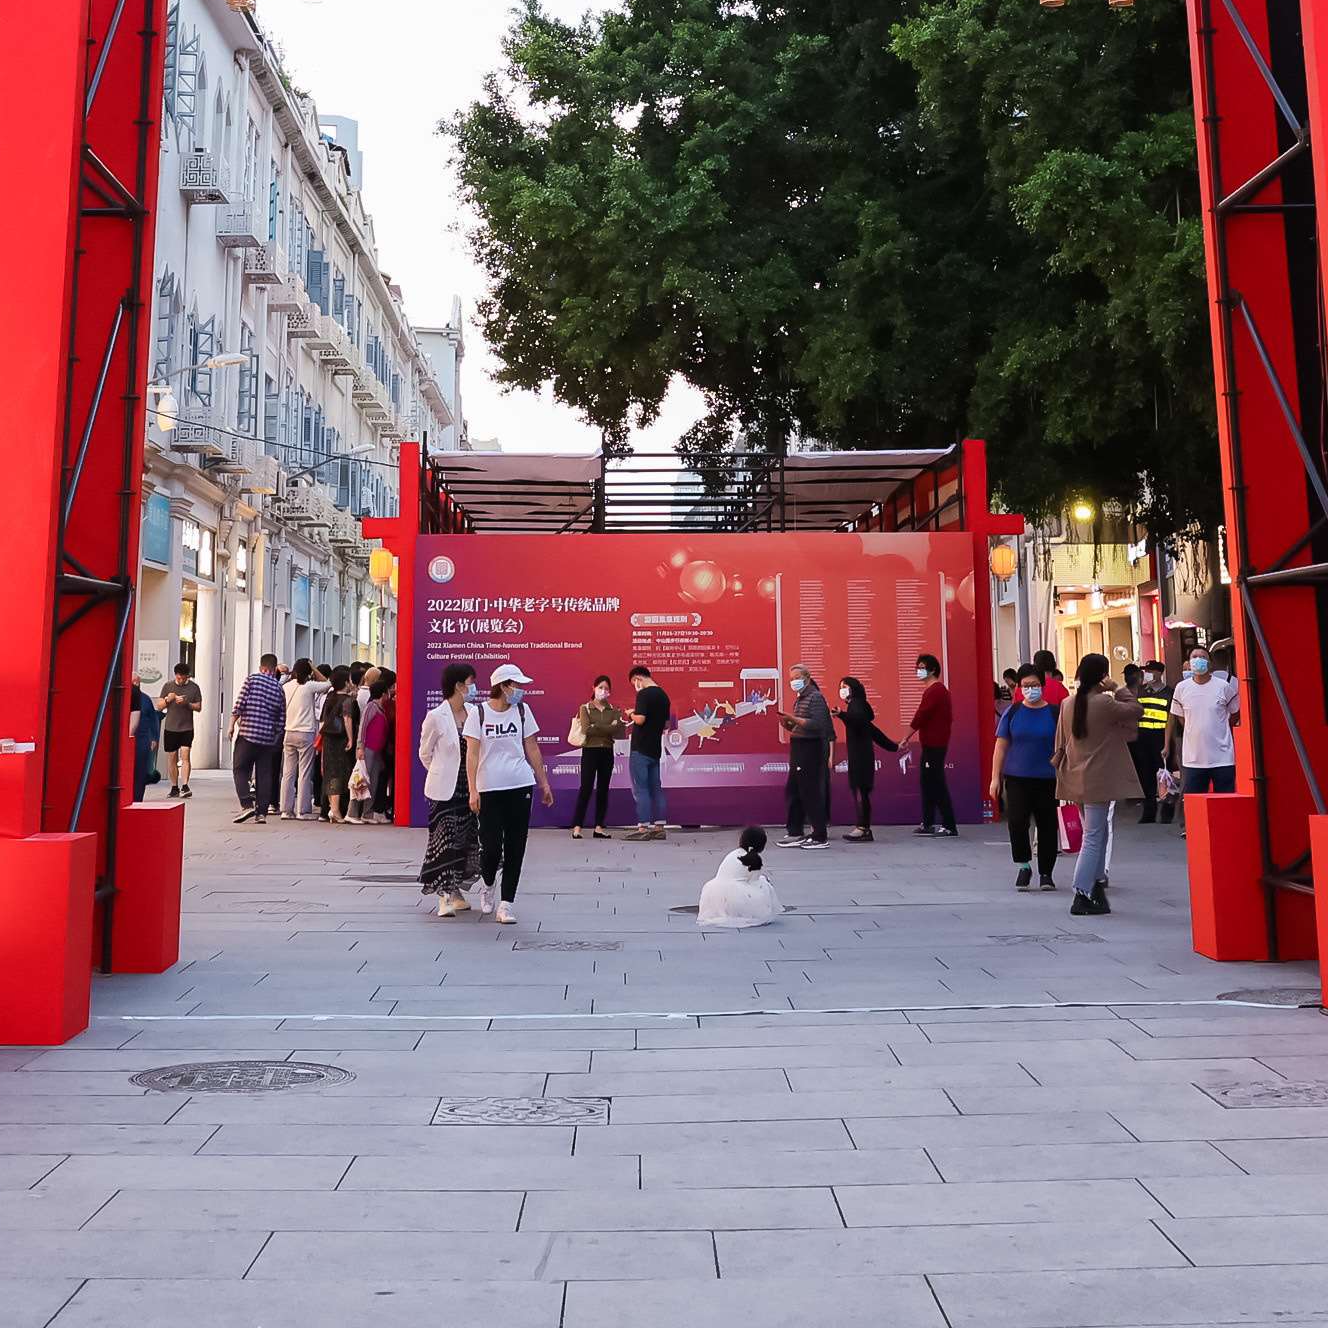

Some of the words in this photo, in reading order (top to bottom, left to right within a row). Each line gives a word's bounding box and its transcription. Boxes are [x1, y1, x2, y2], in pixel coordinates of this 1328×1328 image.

[427, 597, 620, 612] 2022厦门·中华老字号传统品牌
[427, 618, 524, 634] 文化节(展览会)
[474, 652, 510, 660] (Exhibition)
[485, 722, 518, 736] FILA
